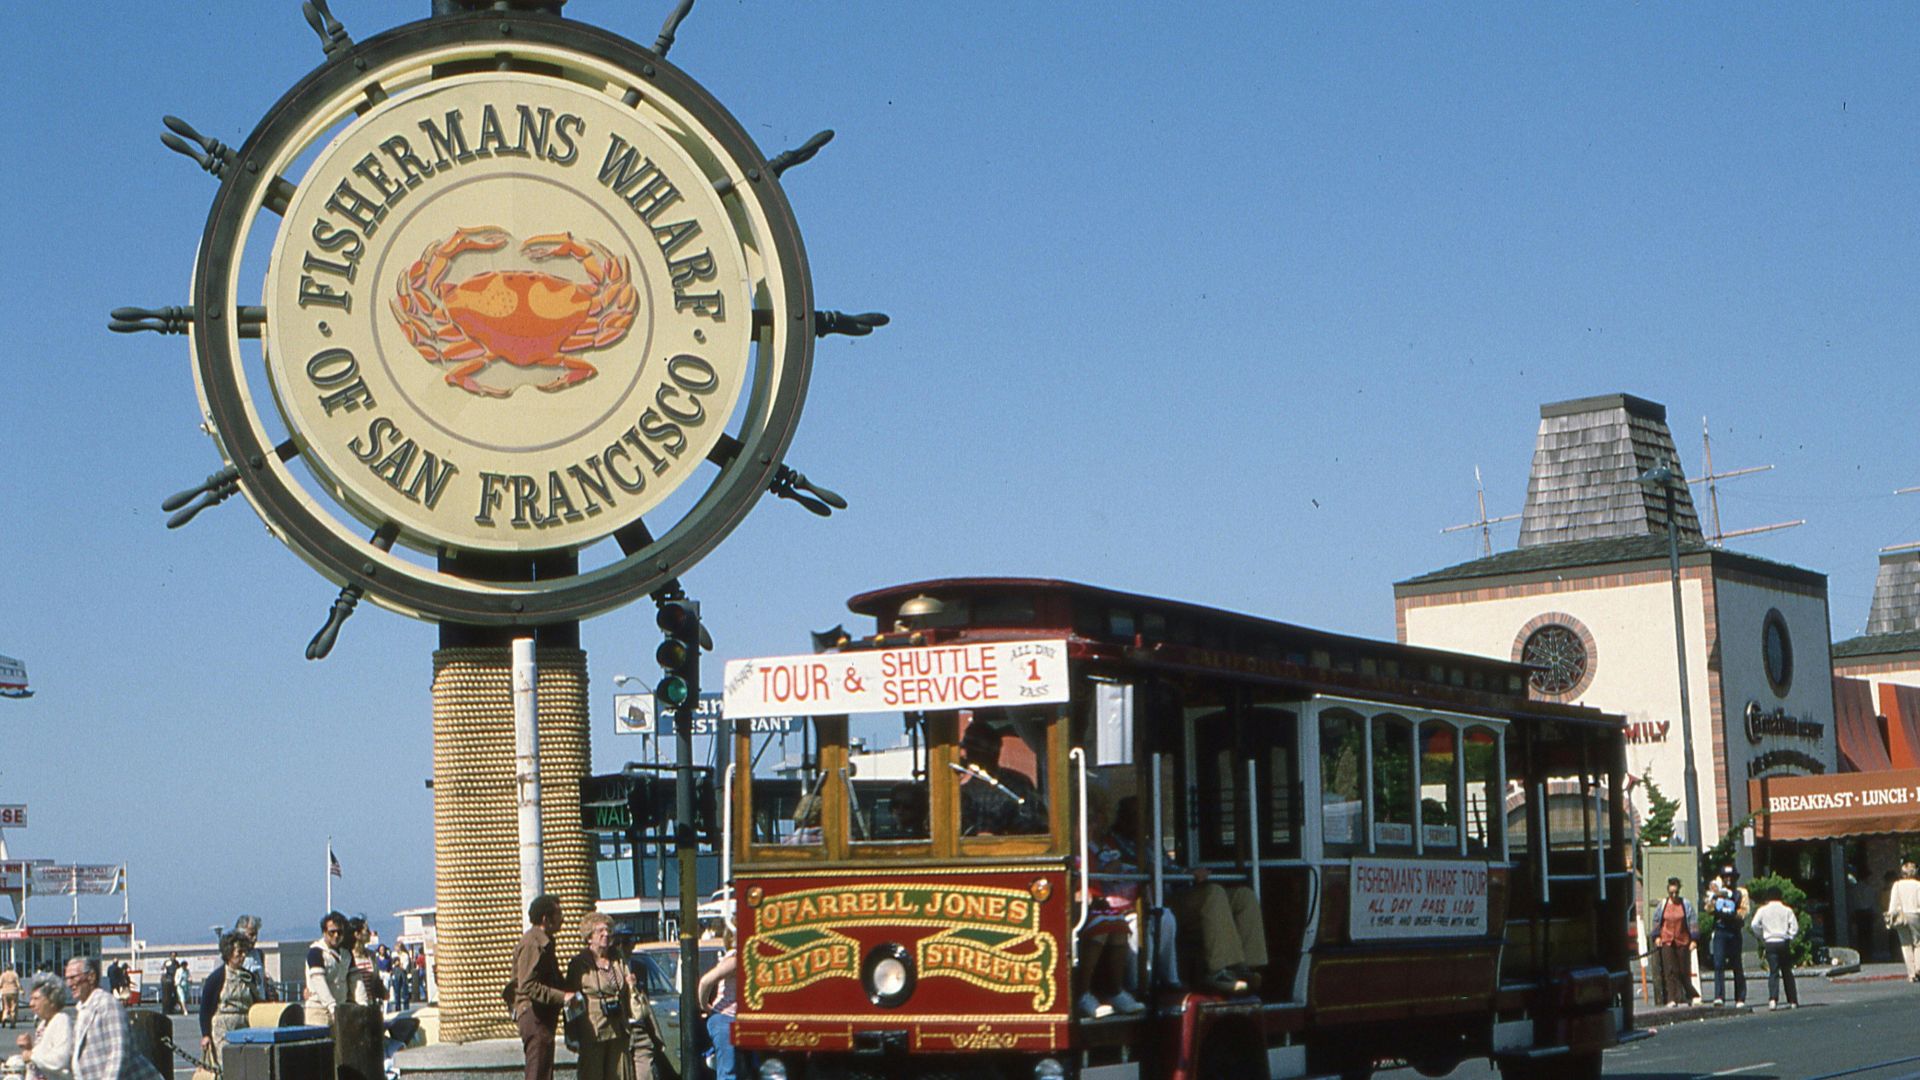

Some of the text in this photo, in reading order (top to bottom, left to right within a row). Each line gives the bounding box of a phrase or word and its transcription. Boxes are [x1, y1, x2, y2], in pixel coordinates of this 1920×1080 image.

[299, 102, 726, 322] FISHERMANS WHARF
[305, 346, 720, 528] OF SAN FRANCISCO
[881, 646, 996, 678] SHUTTLE
[759, 664, 865, 703] TOUR &
[883, 674, 999, 706] SERVICE
[672, 717, 793, 734] STRANT
[1769, 791, 1854, 813] BREAKFAST
[1862, 787, 1908, 806] LUNCH
[596, 806, 629, 827] WAL
[1356, 865, 1487, 897] FISHERMAN'S WHARF TOUR
[924, 891, 1030, 923] JONES
[1369, 898, 1385, 914] ALL
[1391, 898, 1413, 914] DAY
[1420, 898, 1446, 914] PASS
[774, 944, 851, 986] HYDE
[925, 943, 1043, 985] STREETS
